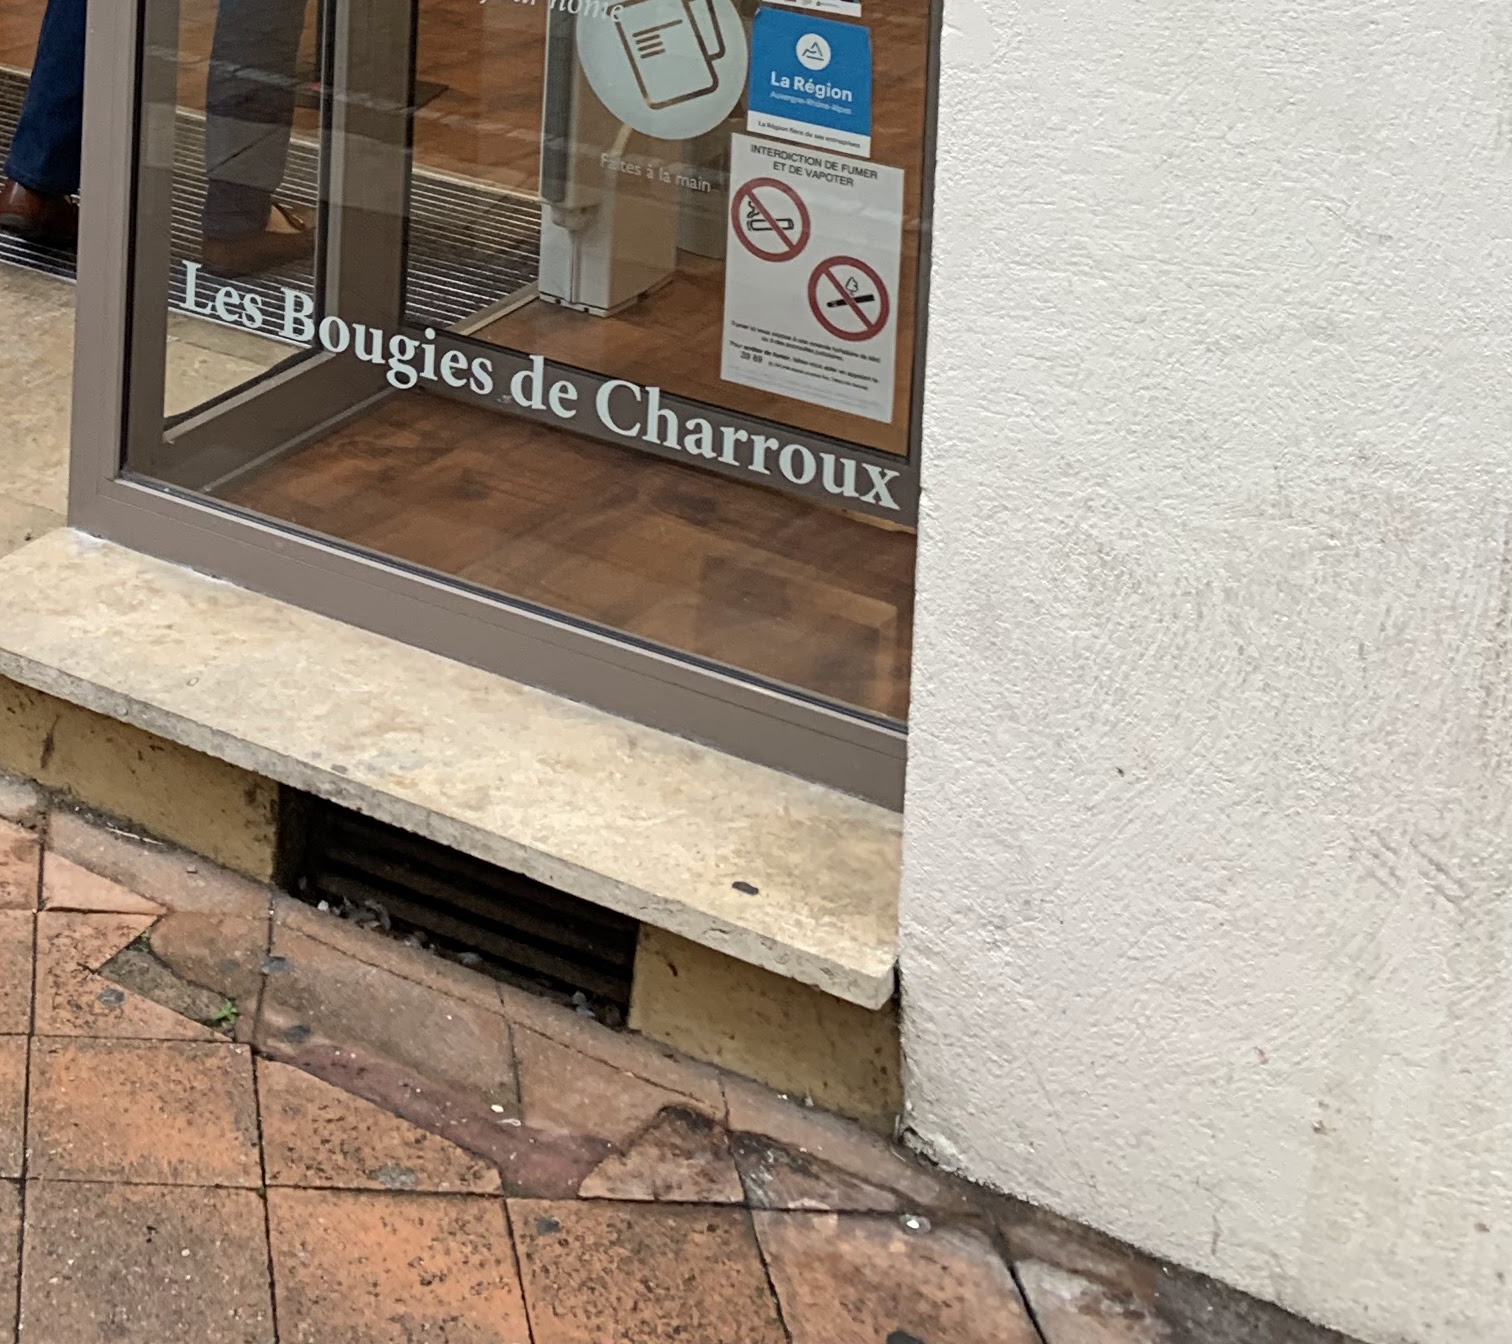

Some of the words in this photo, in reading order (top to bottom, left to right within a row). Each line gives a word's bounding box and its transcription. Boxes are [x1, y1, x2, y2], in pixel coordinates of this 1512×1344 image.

[770, 71, 790, 89] La
[794, 76, 853, 103] Région
[750, 143, 823, 169] INTERDICTION
[824, 159, 839, 172] DE
[841, 164, 879, 180] FUMER
[772, 161, 787, 172] ET
[788, 165, 804, 176] DE
[805, 168, 854, 187] VAPOTER
[659, 166, 671, 184] la
[675, 175, 711, 193] main
[179, 259, 267, 330] Les
[276, 286, 495, 391] Bougies
[509, 354, 579, 419] de
[595, 378, 901, 512] Charroux
